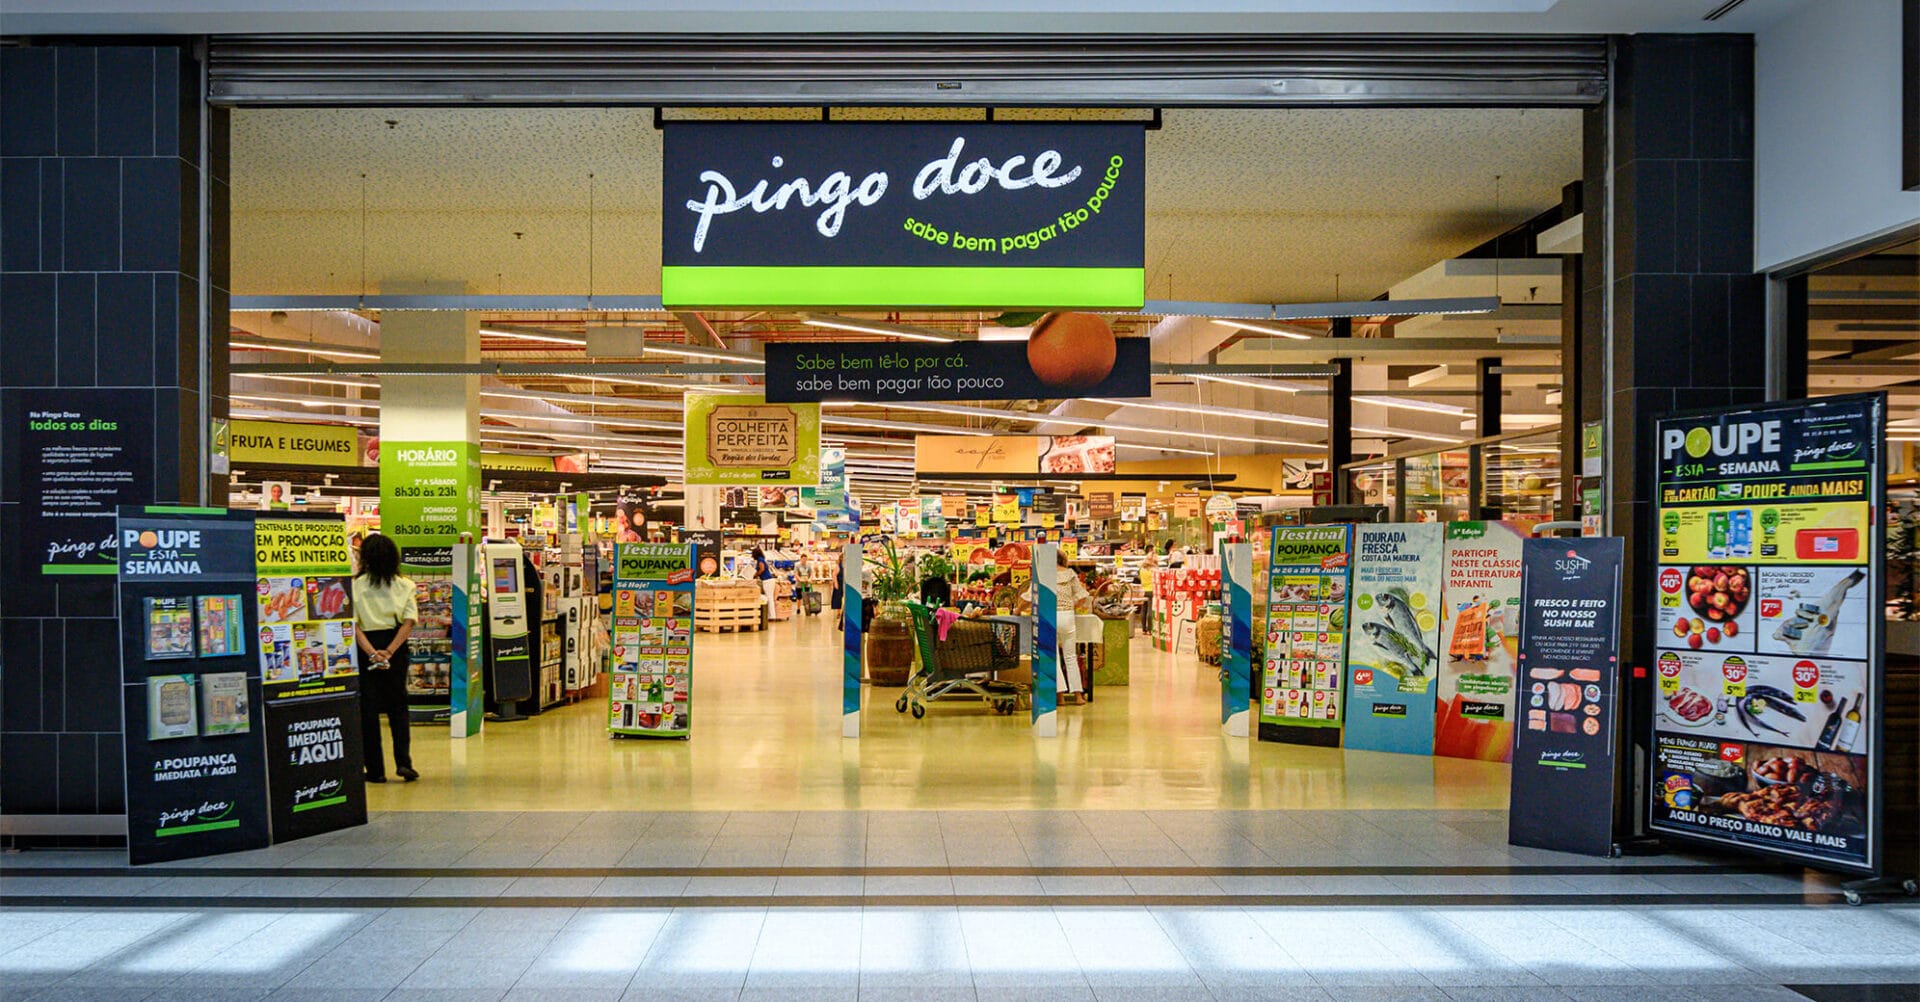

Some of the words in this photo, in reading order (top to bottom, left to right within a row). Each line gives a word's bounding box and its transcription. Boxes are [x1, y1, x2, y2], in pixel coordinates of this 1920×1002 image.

[686, 156, 889, 252] pingo
[912, 136, 1082, 200] doce
[904, 216, 950, 246] sabe
[952, 230, 997, 252] bem
[1001, 226, 1058, 255] pagar
[1057, 207, 1089, 234] tão
[1085, 154, 1124, 214] pouco
[796, 353, 836, 370] Sabe
[841, 353, 873, 369] bem
[879, 352, 910, 369] tê-lo
[914, 357, 939, 373] por
[945, 353, 969, 368] cá.
[796, 374, 833, 391] sabe
[838, 374, 871, 390] bem
[876, 378, 922, 394] pagar
[927, 375, 952, 390] tão
[957, 377, 1005, 393] pouco
[30, 419, 67, 430] todos
[70, 421, 85, 430] os
[89, 419, 118, 430] dias
[716, 421, 789, 433] COLHEITA
[231, 435, 274, 449] FRUTA
[278, 437, 286, 450] E
[290, 438, 351, 453] LEGUMES
[716, 434, 789, 446] PERFEITA
[1663, 420, 1781, 460] POUPE
[397, 447, 457, 462] HORÁRIO
[1793, 446, 1826, 463] pingo
[1827, 441, 1856, 453] doce
[1675, 463, 1704, 477] ESTA
[1718, 460, 1782, 476] SEMANA
[394, 487, 420, 497] 8h30
[423, 487, 434, 497] às
[438, 486, 457, 497] 23h
[1679, 486, 1716, 502] CARTÃO
[1744, 483, 1786, 499] POUPE
[1789, 483, 1819, 496] AINDA
[1820, 480, 1864, 495] MAIS!
[255, 523, 292, 531] CENTENAS
[294, 523, 303, 531] DE
[305, 524, 344, 532] PRODUTOS
[394, 525, 420, 535] 8h30
[423, 525, 435, 535] às
[438, 524, 457, 535] 22h
[124, 530, 201, 549] POUPE
[257, 535, 273, 546] EM
[278, 533, 345, 547] PROMOÇÃO
[1280, 528, 1345, 541] festival
[1362, 531, 1407, 543] DOURADA
[47, 538, 96, 562] pingo
[149, 549, 179, 560] ESTA
[257, 549, 267, 563] O
[271, 546, 296, 563] MÊS
[300, 550, 348, 563] INTEIRO
[623, 543, 690, 556] festival
[1278, 544, 1341, 556] POUPANÇA
[1362, 543, 1398, 554] FRESCA
[1451, 549, 1498, 558] PARTICIPE
[622, 558, 687, 571] POUPANÇA
[1362, 554, 1381, 562] COSTA
[1383, 554, 1391, 562] DA
[1392, 554, 1420, 562] MADEIRA
[1451, 559, 1479, 568] NESTE
[1481, 557, 1523, 568] CLÁSSIC
[125, 560, 202, 575] SEMANA
[1554, 559, 1588, 571] SUSHI
[1450, 569, 1464, 578] DA
[1467, 569, 1522, 578] LITERATURA
[1450, 579, 1494, 588] INFANTIL
[1534, 599, 1570, 608] FRESCO
[1571, 599, 1578, 608] E
[1579, 599, 1606, 608] FEITO
[1542, 610, 1559, 618] NO
[1560, 610, 1597, 619] NOSSO
[1543, 619, 1572, 628] SUSHI
[1574, 619, 1594, 628] BAR
[1465, 704, 1482, 713] pingo
[1483, 702, 1499, 711] doce
[293, 717, 342, 732] POUPANÇA
[288, 728, 343, 748] IMEDIATA
[299, 741, 344, 766] AQUI
[1541, 750, 1561, 760] pingo
[155, 760, 161, 769] A
[164, 753, 237, 769] POUPANÇA
[154, 769, 201, 782] IMEDIATA
[211, 765, 237, 776] AQUI
[294, 785, 318, 803] pingo
[319, 780, 339, 792] doce
[159, 807, 196, 828] pingo
[198, 801, 228, 814] doce
[1669, 809, 1695, 823] AQUI
[1698, 814, 1707, 824] O
[1709, 816, 1743, 831] PREÇO
[1746, 822, 1782, 838] BAIXO
[1784, 828, 1813, 843] VALE
[1815, 833, 1847, 849] MAIS
